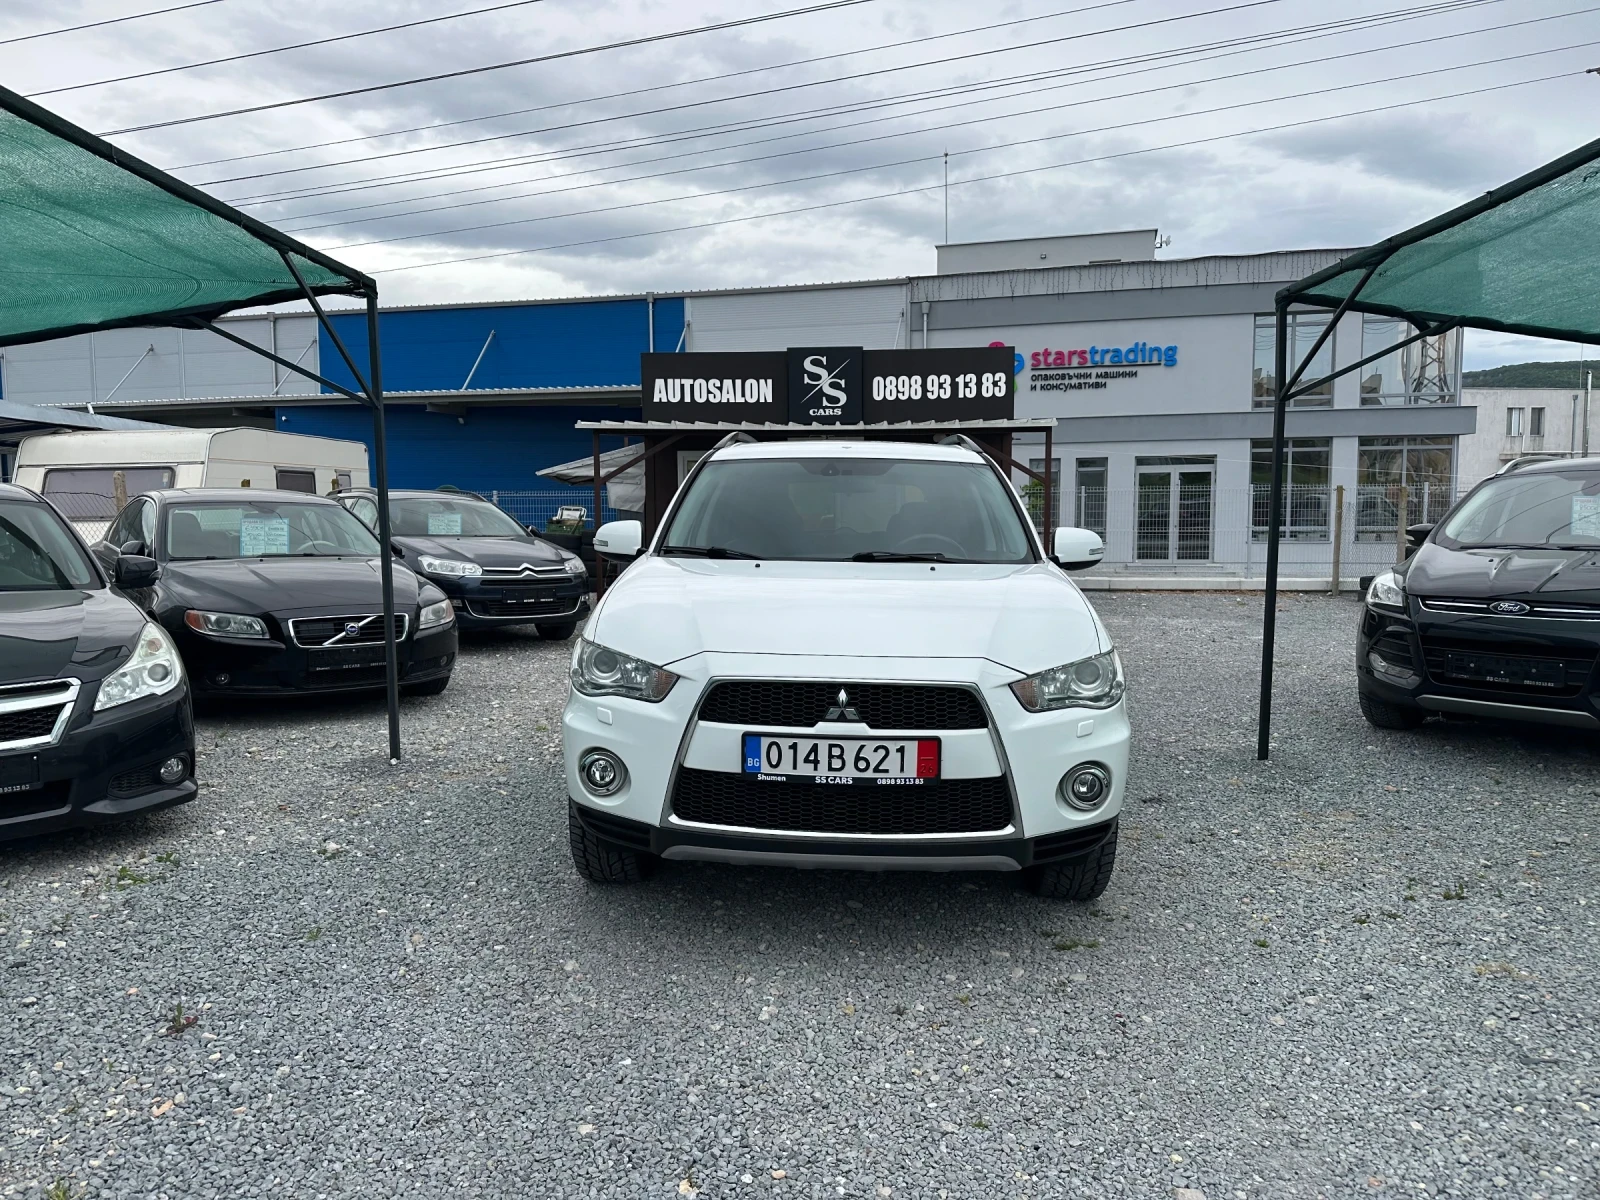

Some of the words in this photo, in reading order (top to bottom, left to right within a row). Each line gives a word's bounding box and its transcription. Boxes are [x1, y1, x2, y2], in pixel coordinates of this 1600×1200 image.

[1030, 342, 1178, 367] starstrading
[1030, 371, 1093, 382] опаковъчни
[1095, 370, 1138, 379] машини
[653, 378, 773, 403] AUTOSALON
[872, 375, 922, 400] 0898
[926, 374, 951, 399] 93
[955, 373, 977, 398] 13
[981, 372, 1007, 398] 83
[1040, 381, 1107, 392] консумативи
[809, 408, 842, 416] CARS
[1497, 602, 1521, 612] Ford
[747, 758, 760, 767] BG
[757, 773, 786, 782] Shumen
[815, 775, 827, 784] SS
[828, 776, 853, 785] CARS
